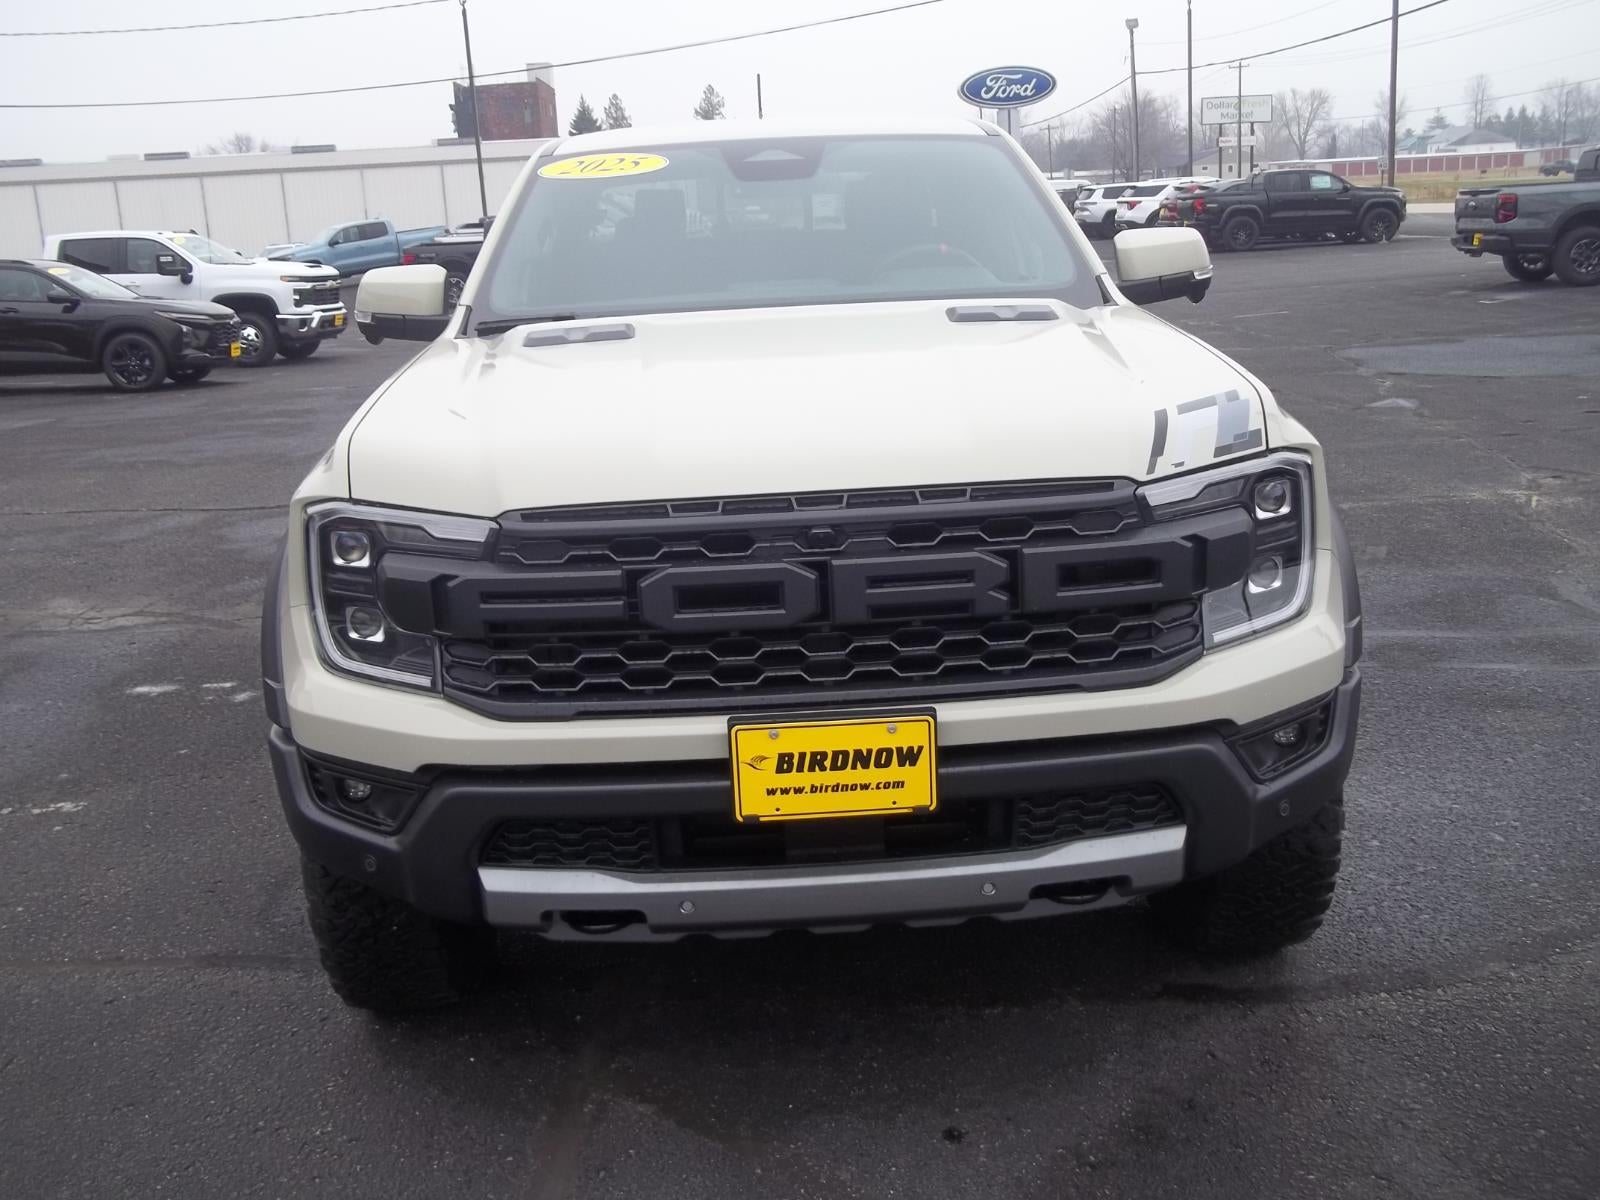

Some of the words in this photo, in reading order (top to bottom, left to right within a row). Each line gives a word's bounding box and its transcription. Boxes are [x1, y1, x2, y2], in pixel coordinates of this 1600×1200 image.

[981, 74, 1036, 99] Ford
[1206, 100, 1233, 110] Dollar
[557, 157, 649, 175] 2025
[446, 537, 1193, 637] FORD
[775, 745, 924, 774] BIRDNOW
[766, 780, 905, 796] www.birdnow.com
